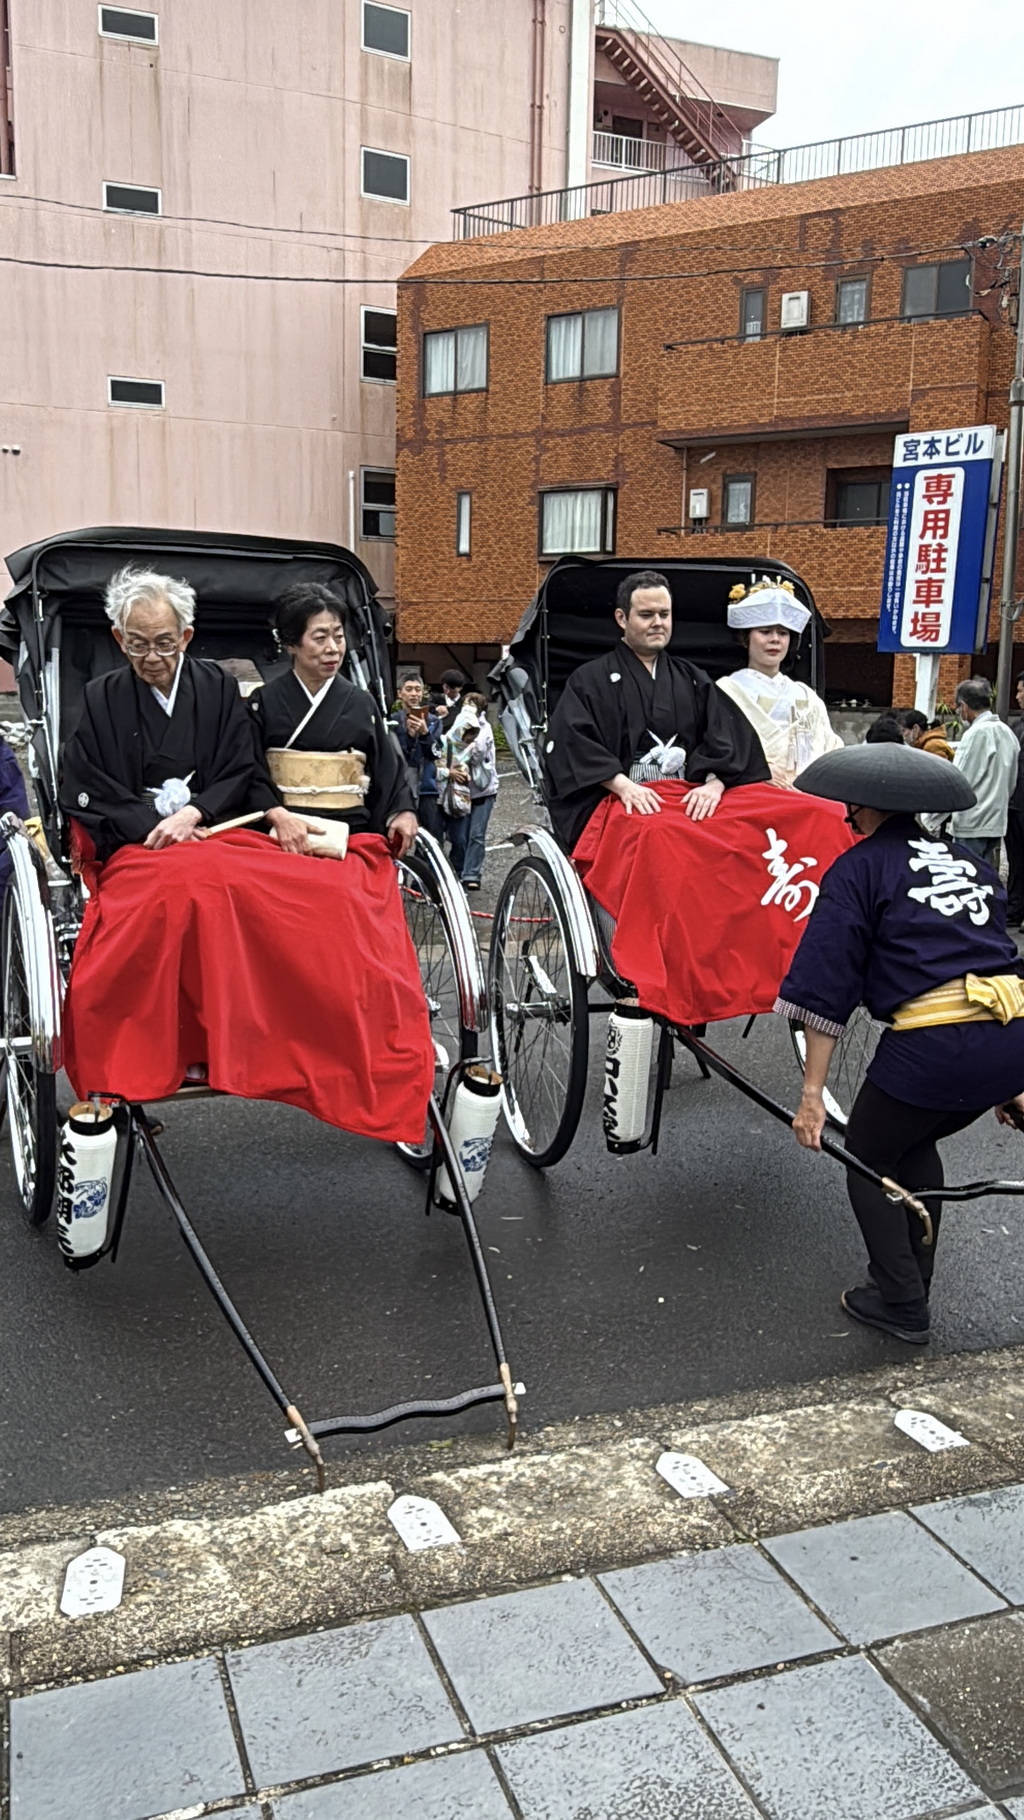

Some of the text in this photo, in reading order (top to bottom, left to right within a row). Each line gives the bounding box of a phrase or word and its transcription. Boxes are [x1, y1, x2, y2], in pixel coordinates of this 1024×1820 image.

[902, 433, 984, 462] 宮本ビル
[909, 473, 956, 643] 専用駐車場
